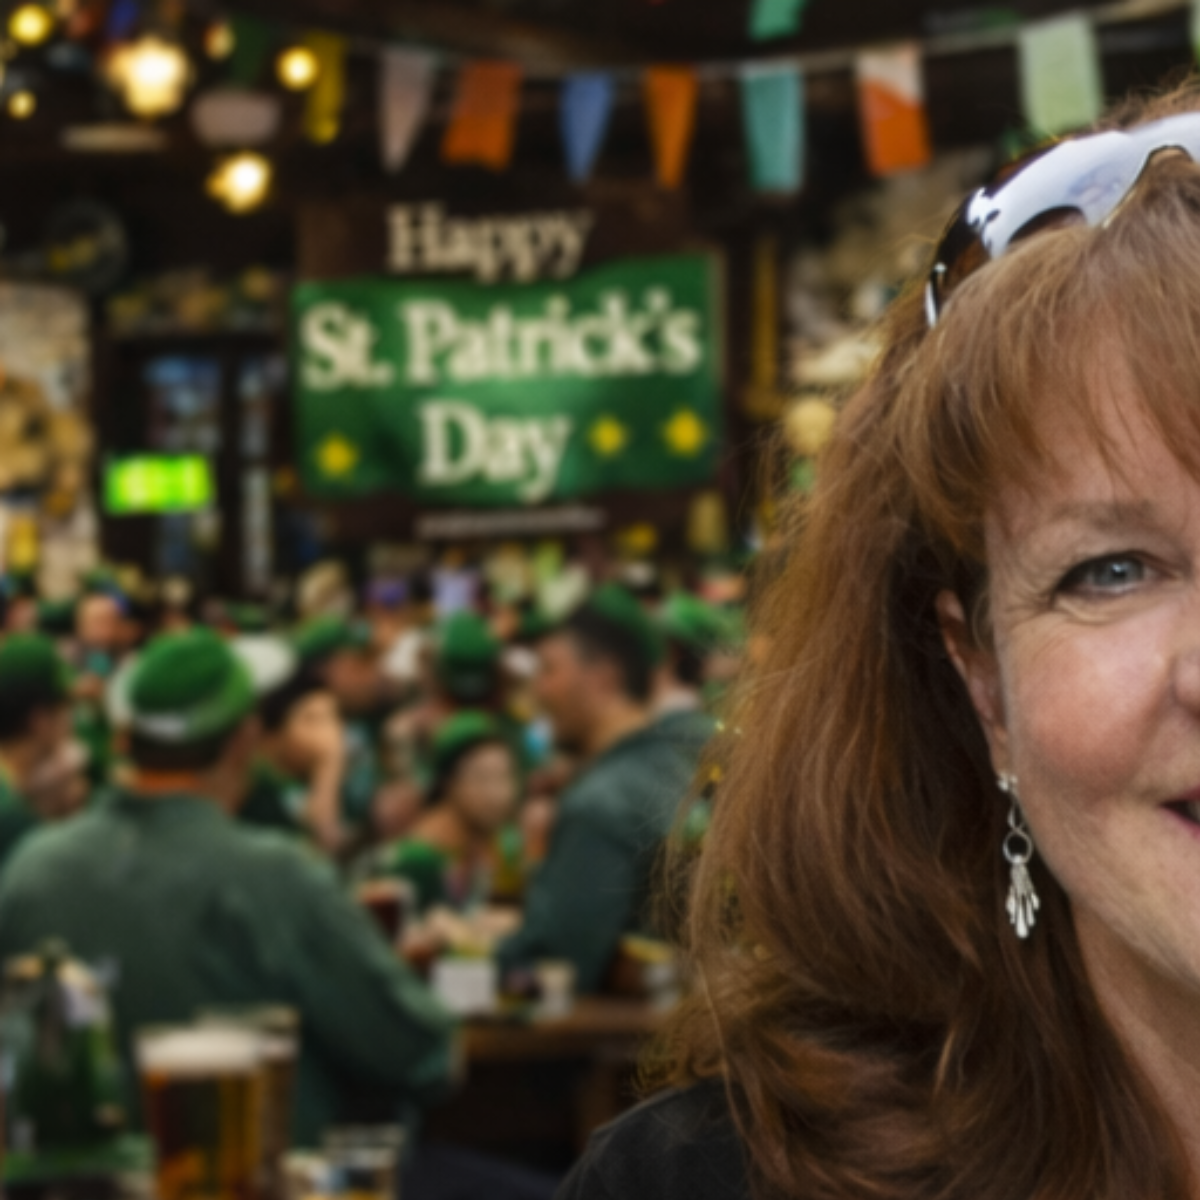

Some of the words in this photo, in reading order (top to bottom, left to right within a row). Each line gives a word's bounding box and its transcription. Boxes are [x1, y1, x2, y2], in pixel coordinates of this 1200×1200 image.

[388, 205, 592, 282] Happy
[302, 303, 396, 390] St.
[402, 290, 702, 384] Patrick's
[420, 398, 572, 501] Day
